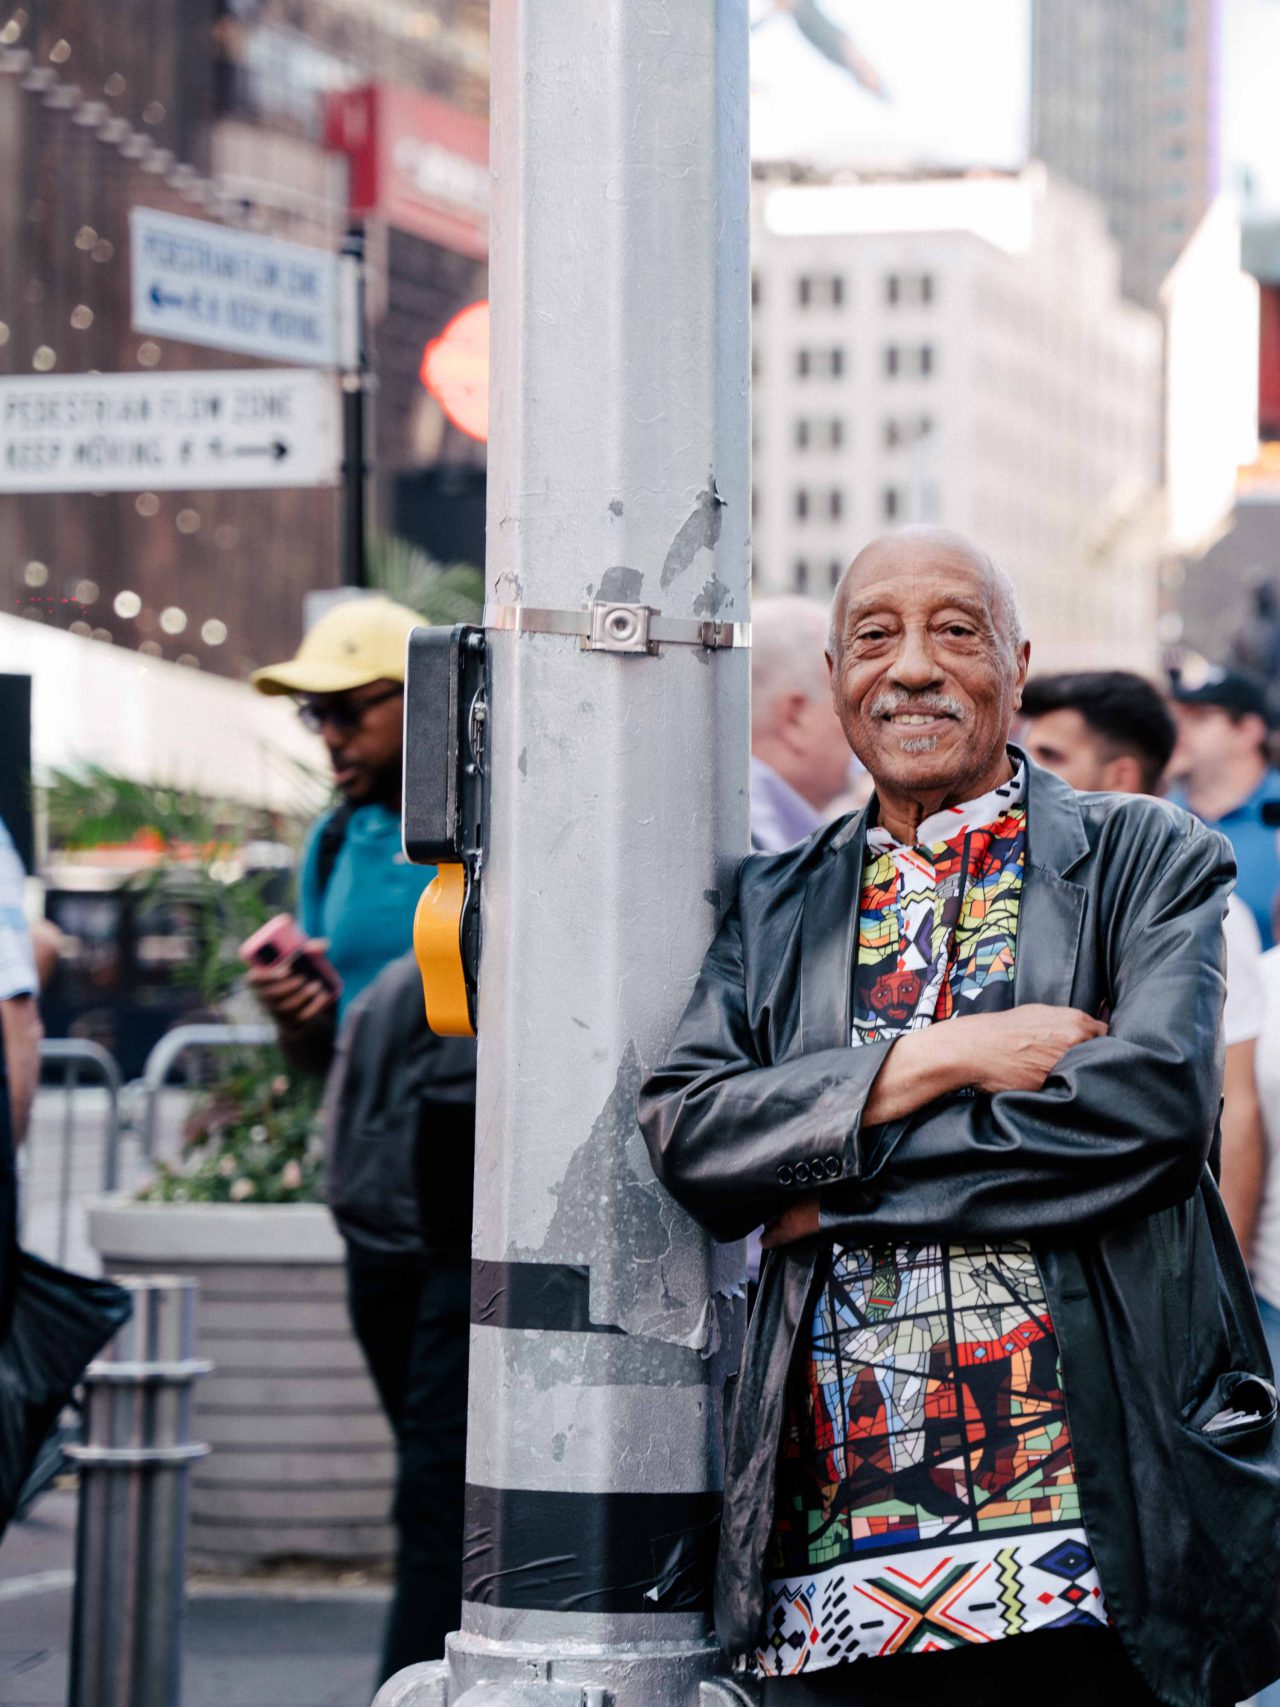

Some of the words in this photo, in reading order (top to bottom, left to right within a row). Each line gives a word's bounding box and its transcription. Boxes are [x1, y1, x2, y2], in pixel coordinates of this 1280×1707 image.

[5, 389, 149, 428] PEDESTRIAN
[160, 389, 221, 423] FLOW
[232, 386, 292, 422] ZONE
[5, 440, 61, 474] KEEP
[75, 438, 163, 472] MOVING
